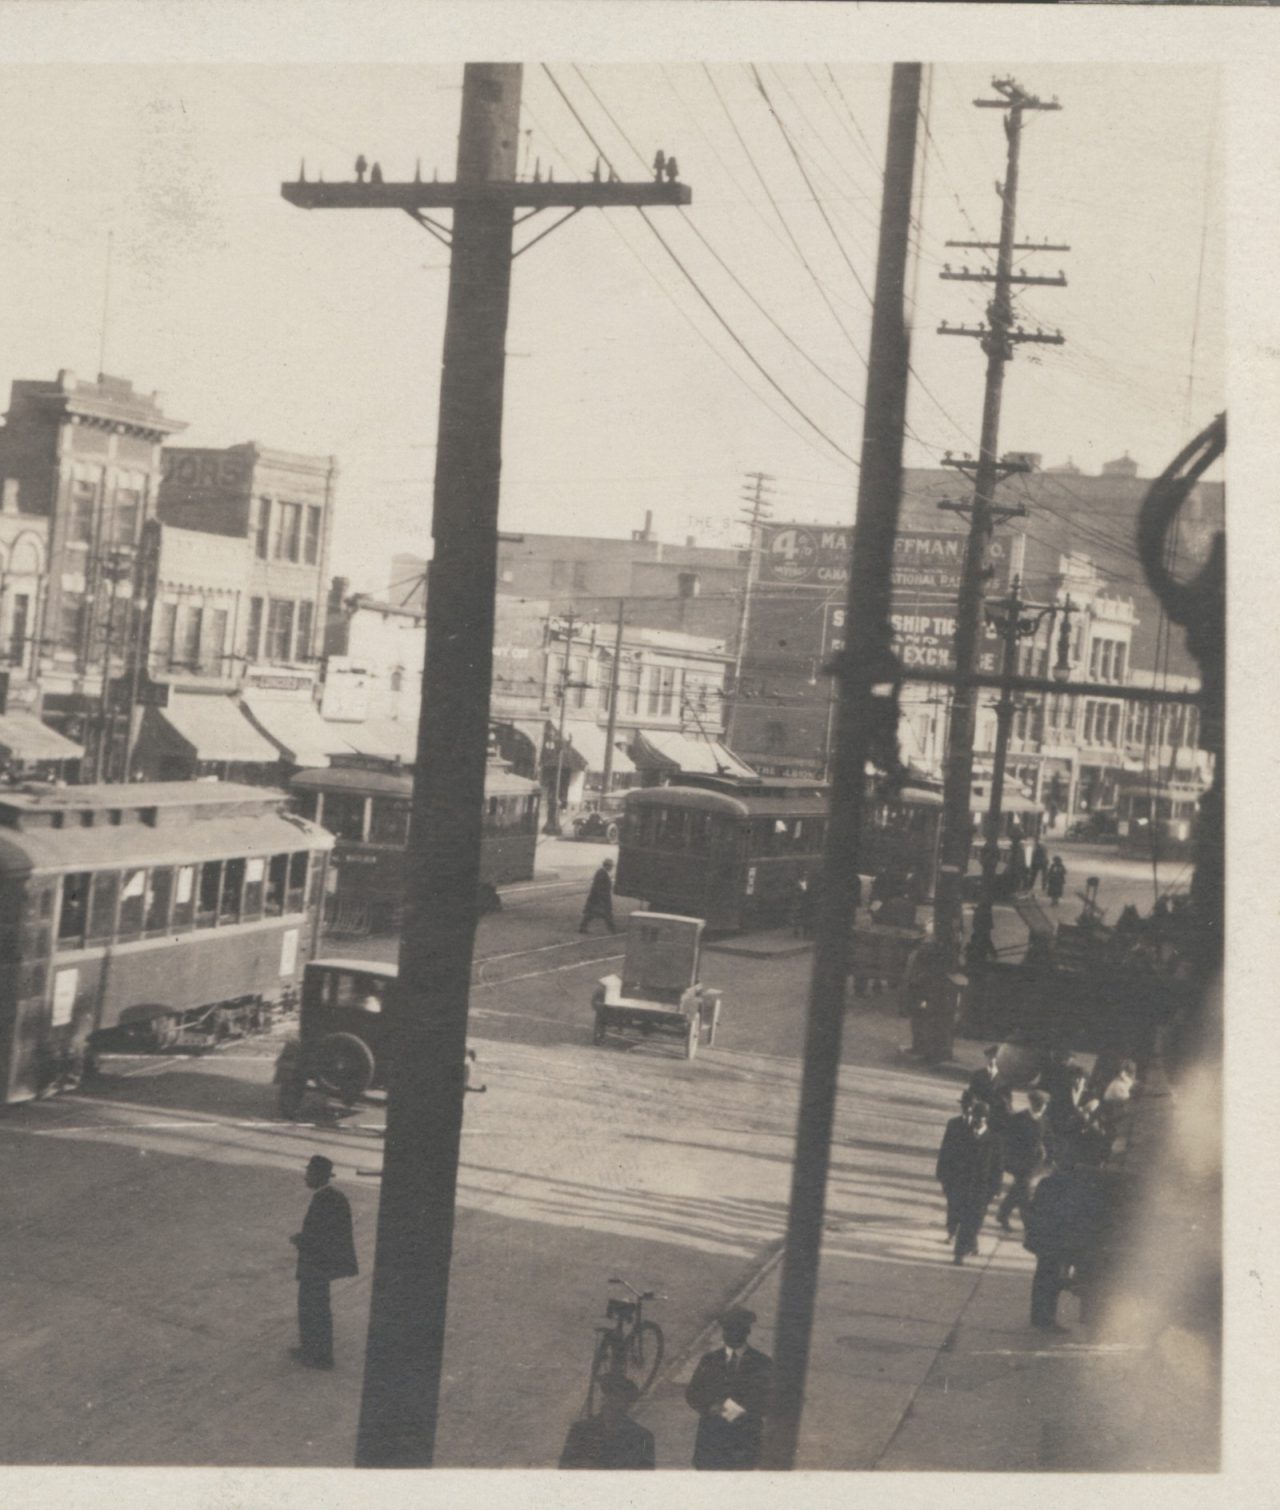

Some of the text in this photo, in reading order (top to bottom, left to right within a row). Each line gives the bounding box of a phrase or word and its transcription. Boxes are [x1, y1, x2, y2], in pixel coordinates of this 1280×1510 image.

[821, 532, 850, 549] MA
[893, 538, 958, 556] FFMAN
[832, 609, 930, 634] SSHIP
